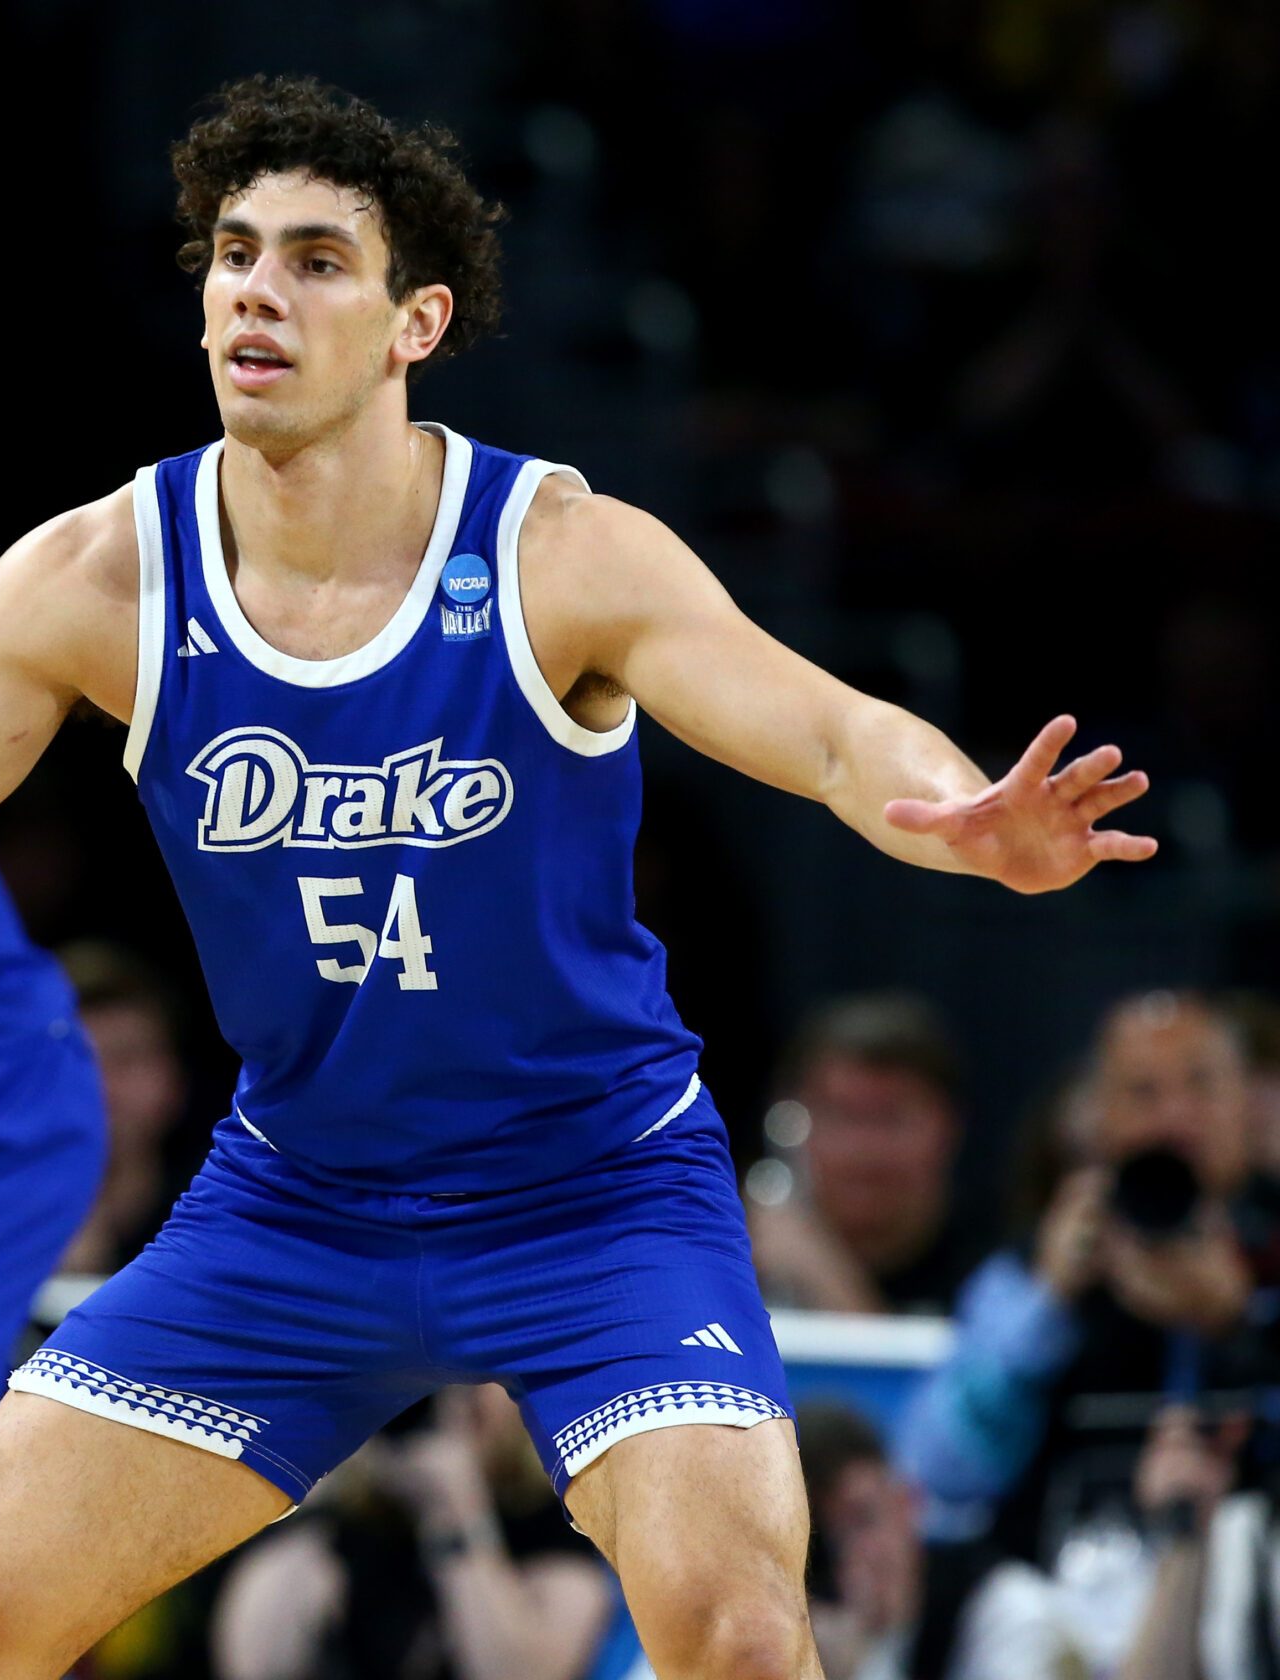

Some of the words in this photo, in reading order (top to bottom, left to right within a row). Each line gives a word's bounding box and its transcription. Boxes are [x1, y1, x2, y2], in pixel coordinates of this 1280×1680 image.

[440, 599, 493, 635] VALLEY
[448, 576, 489, 591] NCAA
[185, 726, 514, 852] Drake
[297, 873, 438, 991] 54
